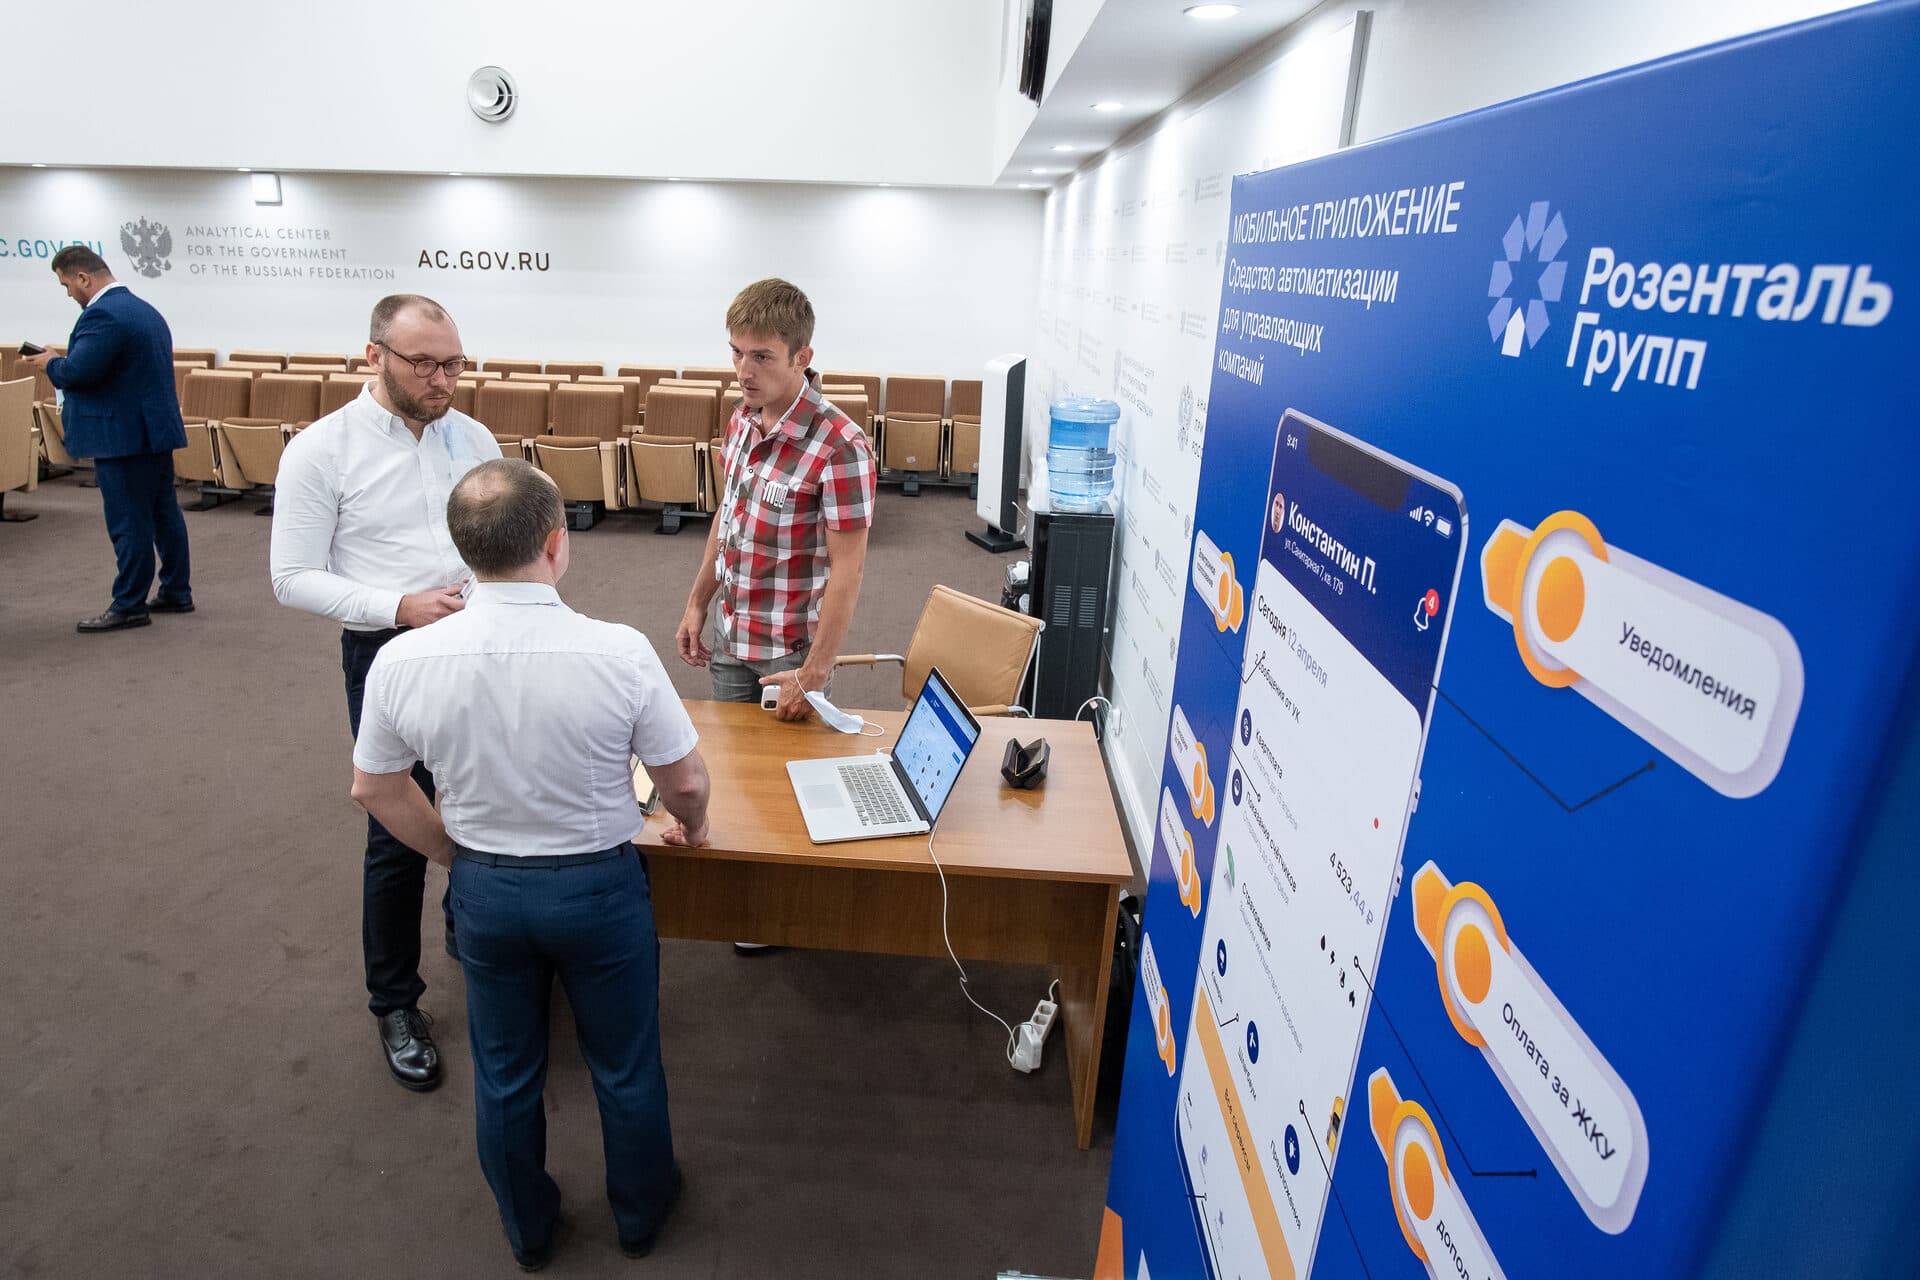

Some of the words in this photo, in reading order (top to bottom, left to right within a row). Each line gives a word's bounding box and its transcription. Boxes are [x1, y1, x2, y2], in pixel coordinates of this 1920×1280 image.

[1232, 205, 1309, 244] МОБИЛЬНОЕ
[1309, 181, 1465, 241] ПРИЛОЖЕНИЕ
[185, 225, 270, 239] ANALYTICAL
[277, 228, 331, 240] CENTER
[187, 244, 214, 257] FOR
[219, 245, 244, 257] THE
[250, 246, 347, 260] GOVERNMENT
[189, 263, 207, 275] OF
[212, 264, 238, 276] THE
[245, 265, 303, 278] RUSSIAN
[309, 267, 396, 280] FEDERATION
[418, 249, 550, 272] AC.GOV.RU
[1228, 257, 1275, 296] Средство
[1277, 267, 1399, 310] автоматизации
[1579, 246, 1893, 327] Розенталь
[1222, 307, 1240, 334] для
[1239, 311, 1324, 357] управляющих
[1217, 347, 1264, 386] компаний
[1566, 311, 1707, 393] Групп
[1286, 434, 1298, 450] 9:41
[1288, 501, 1361, 580] Константин
[1360, 555, 1377, 595] П.
[1332, 576, 1344, 595] 179
[1428, 596, 1435, 610] 4
[1258, 594, 1287, 640] Сегодня
[1287, 627, 1297, 652] 12
[1296, 643, 1328, 689] апреля
[1618, 621, 1757, 720] Уведомления
[1292, 703, 1301, 724] УК
[1329, 852, 1336, 868] 4
[1502, 1002, 1550, 1080] Оплата
[1551, 1076, 1570, 1108] за
[1571, 1097, 1616, 1161] ЖКУ
